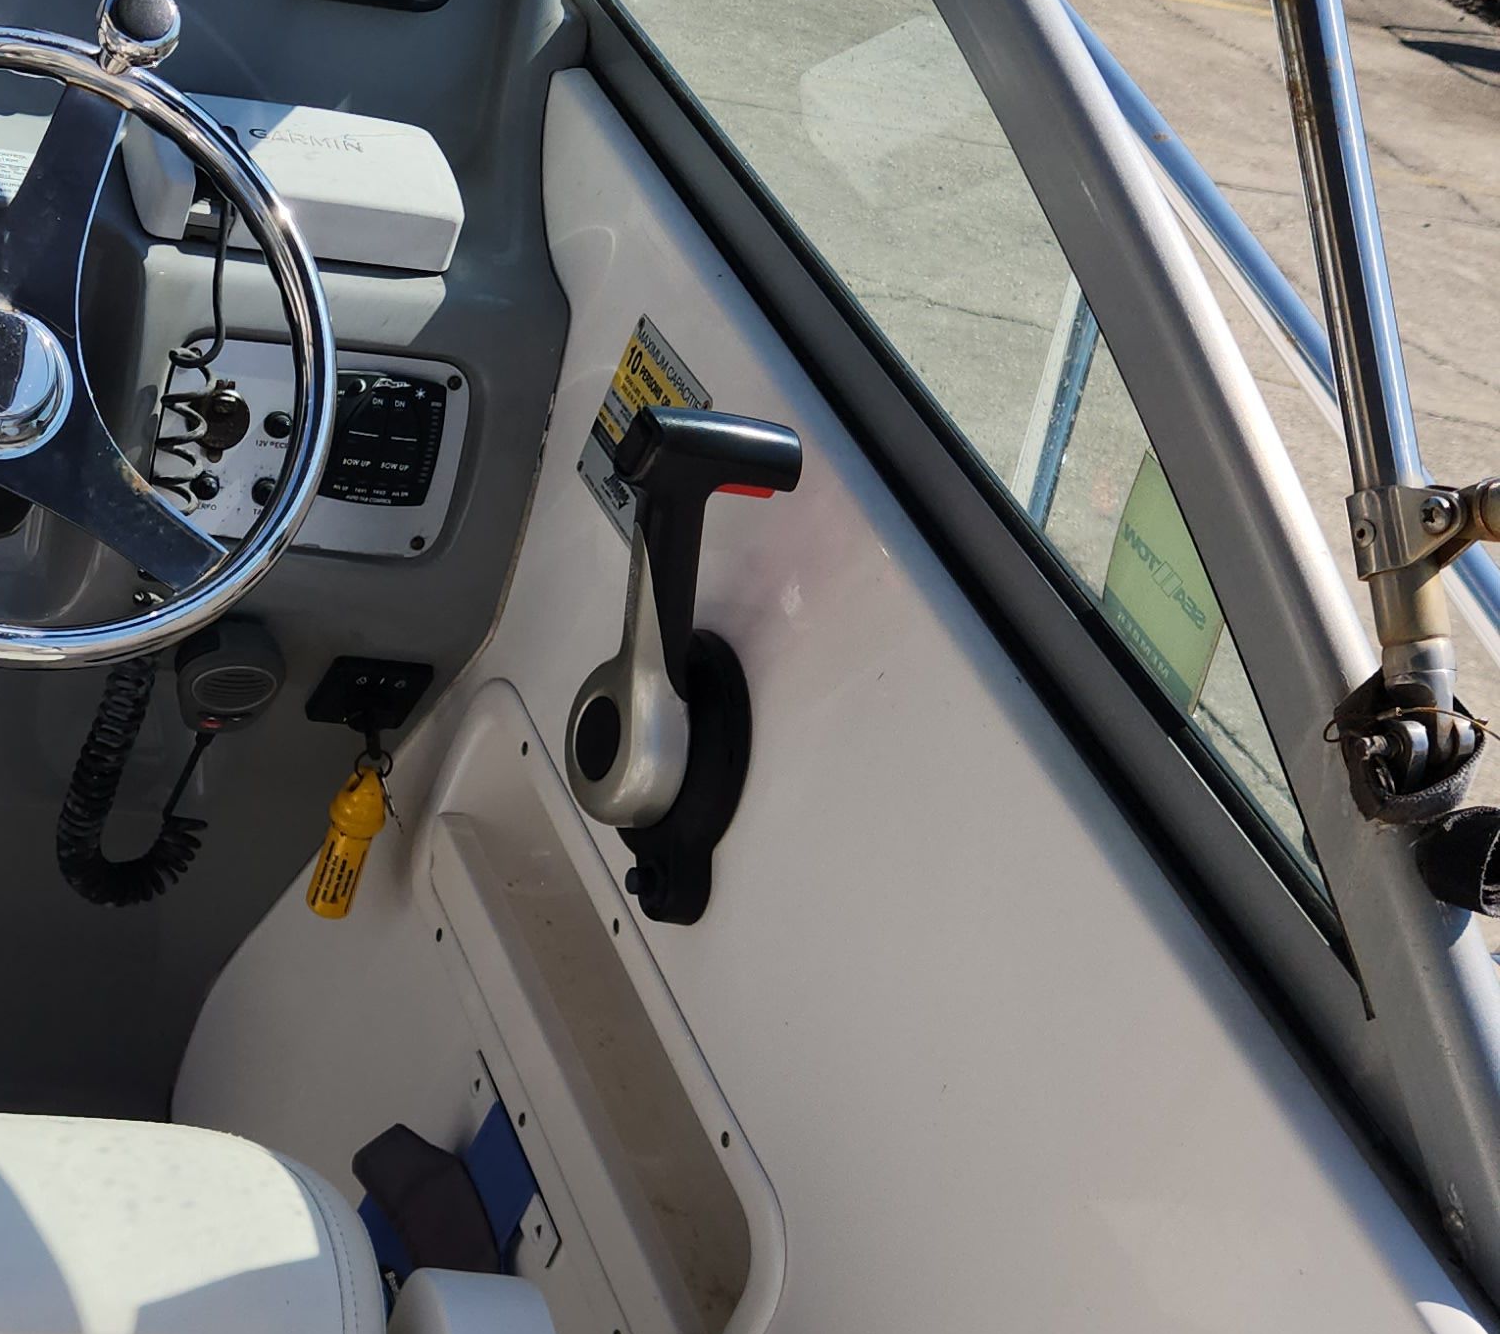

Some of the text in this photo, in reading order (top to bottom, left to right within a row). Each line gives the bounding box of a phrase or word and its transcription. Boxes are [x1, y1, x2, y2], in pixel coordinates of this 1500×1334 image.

[248, 128, 365, 154] GARMIN
[637, 330, 669, 373] MAXIMUM
[626, 345, 643, 375] 10
[639, 365, 663, 401] PERSONS
[255, 439, 268, 449] 12V
[342, 457, 371, 467] BOW UP
[380, 461, 410, 471] BOW UP
